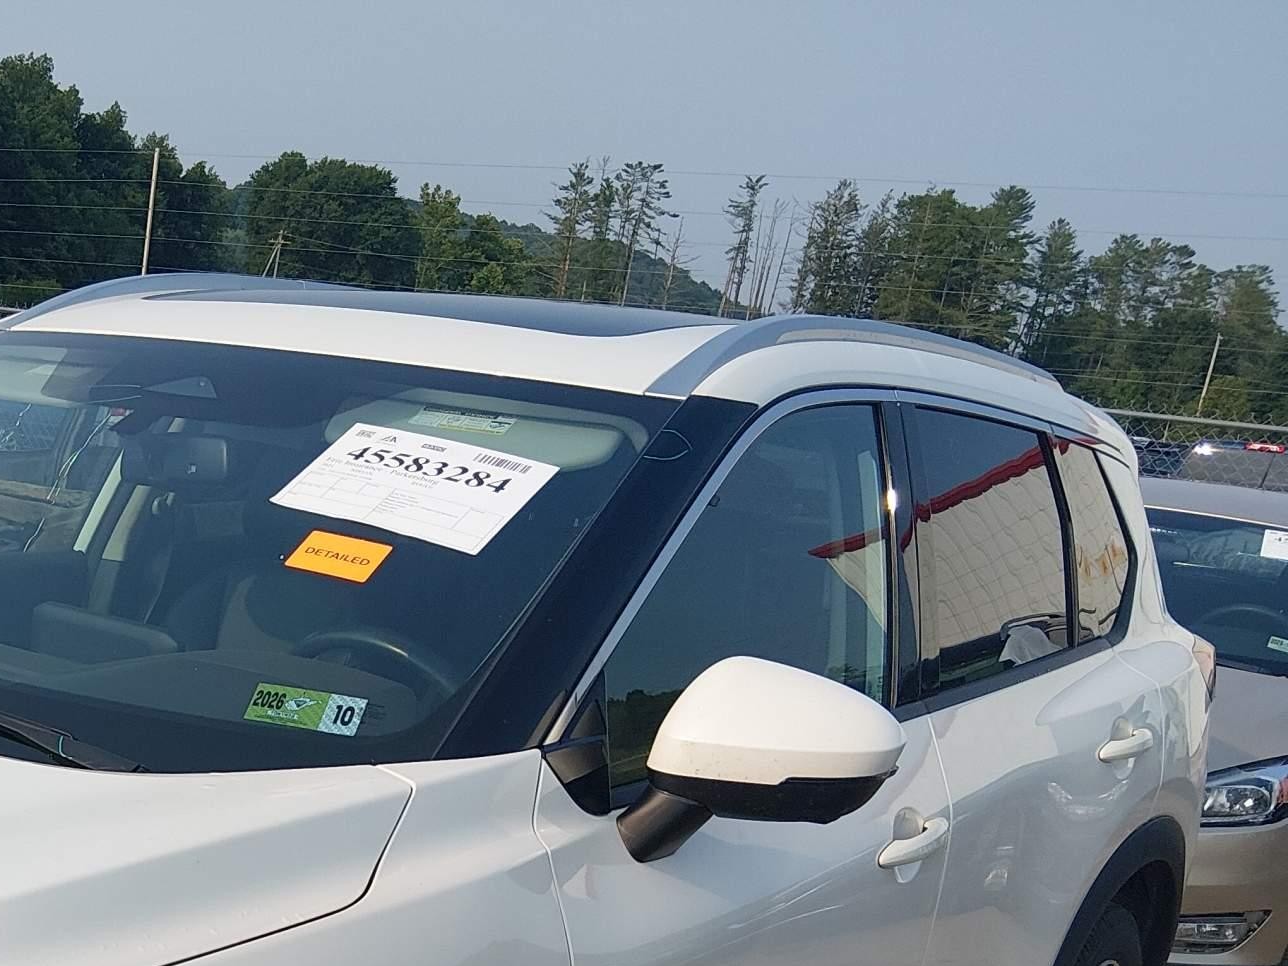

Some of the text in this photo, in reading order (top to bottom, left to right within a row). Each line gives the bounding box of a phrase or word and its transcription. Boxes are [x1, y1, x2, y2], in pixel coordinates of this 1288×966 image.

[346, 446, 513, 494] 45583284
[305, 546, 370, 567] DETAILED
[252, 690, 287, 710] 2026
[332, 705, 355, 727] 10
